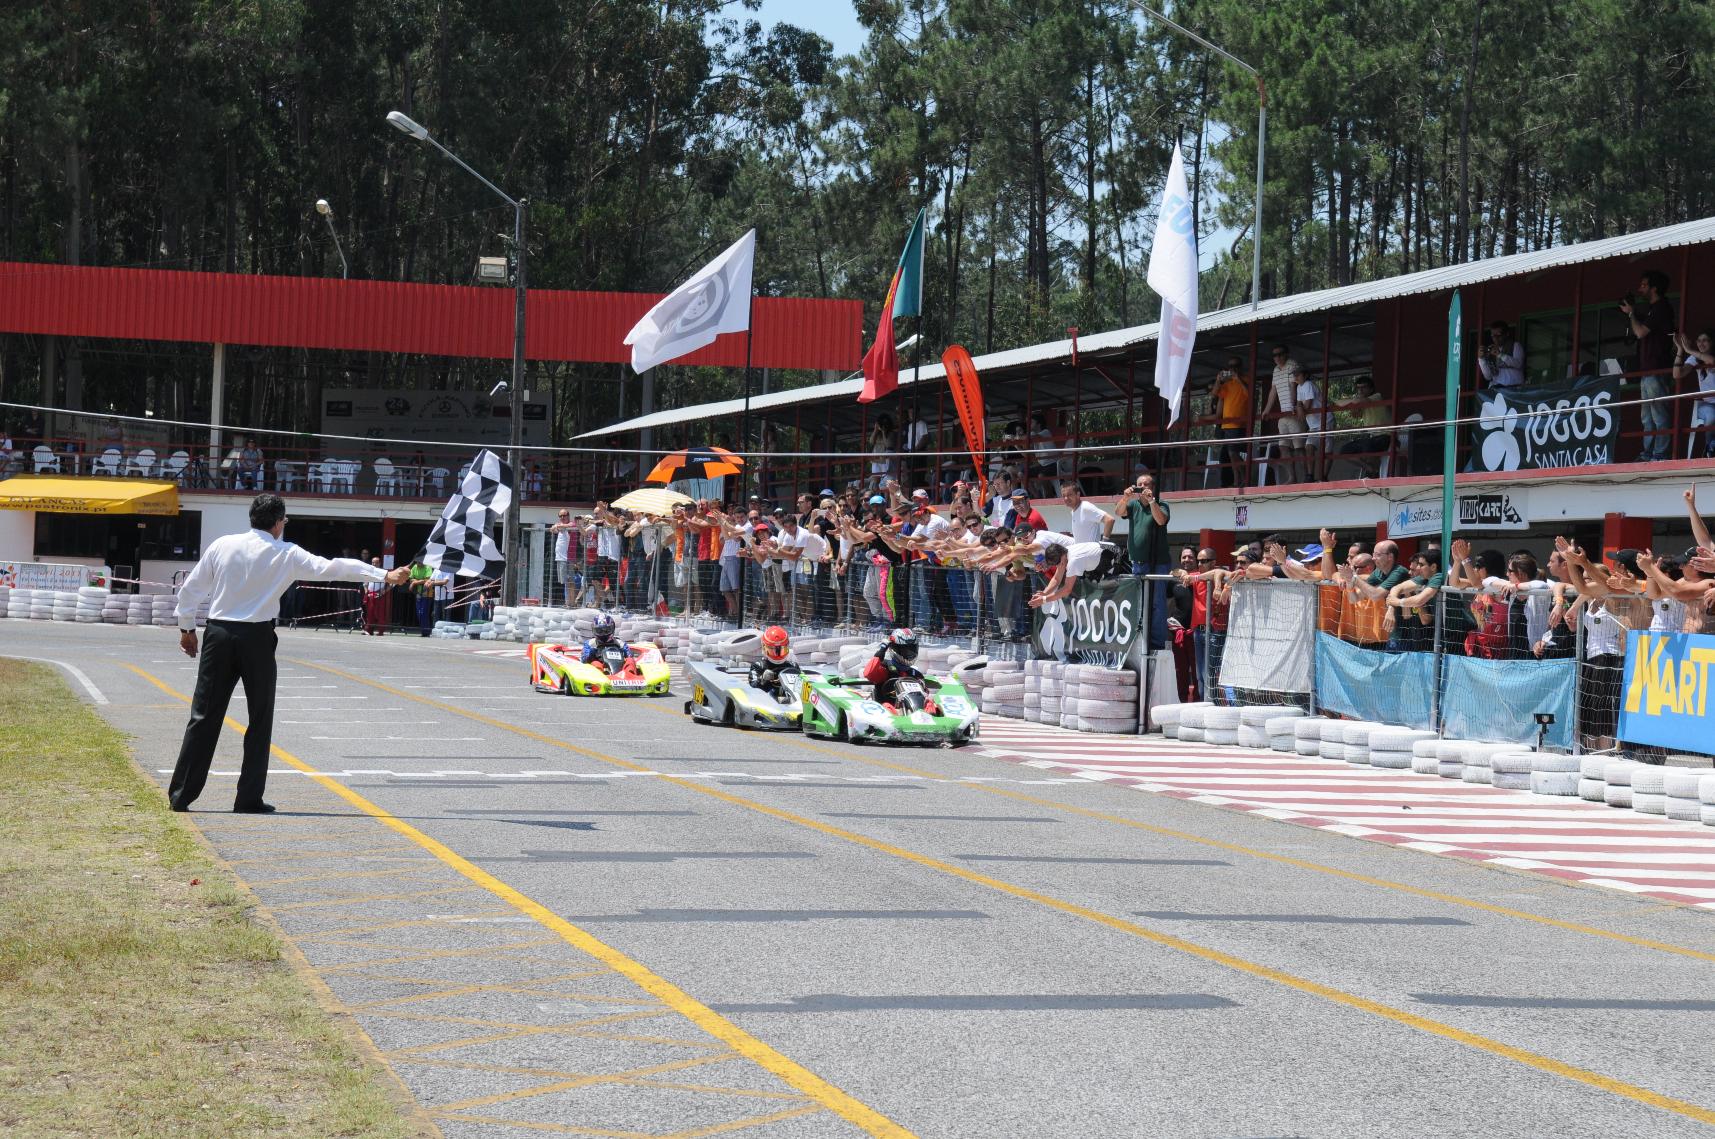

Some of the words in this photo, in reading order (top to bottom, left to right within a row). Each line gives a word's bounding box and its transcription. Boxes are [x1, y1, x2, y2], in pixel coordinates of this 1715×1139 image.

[1525, 391, 1612, 463] JOGOS
[1460, 498, 1478, 521] VIRUS
[1068, 598, 1132, 654] JOGOS
